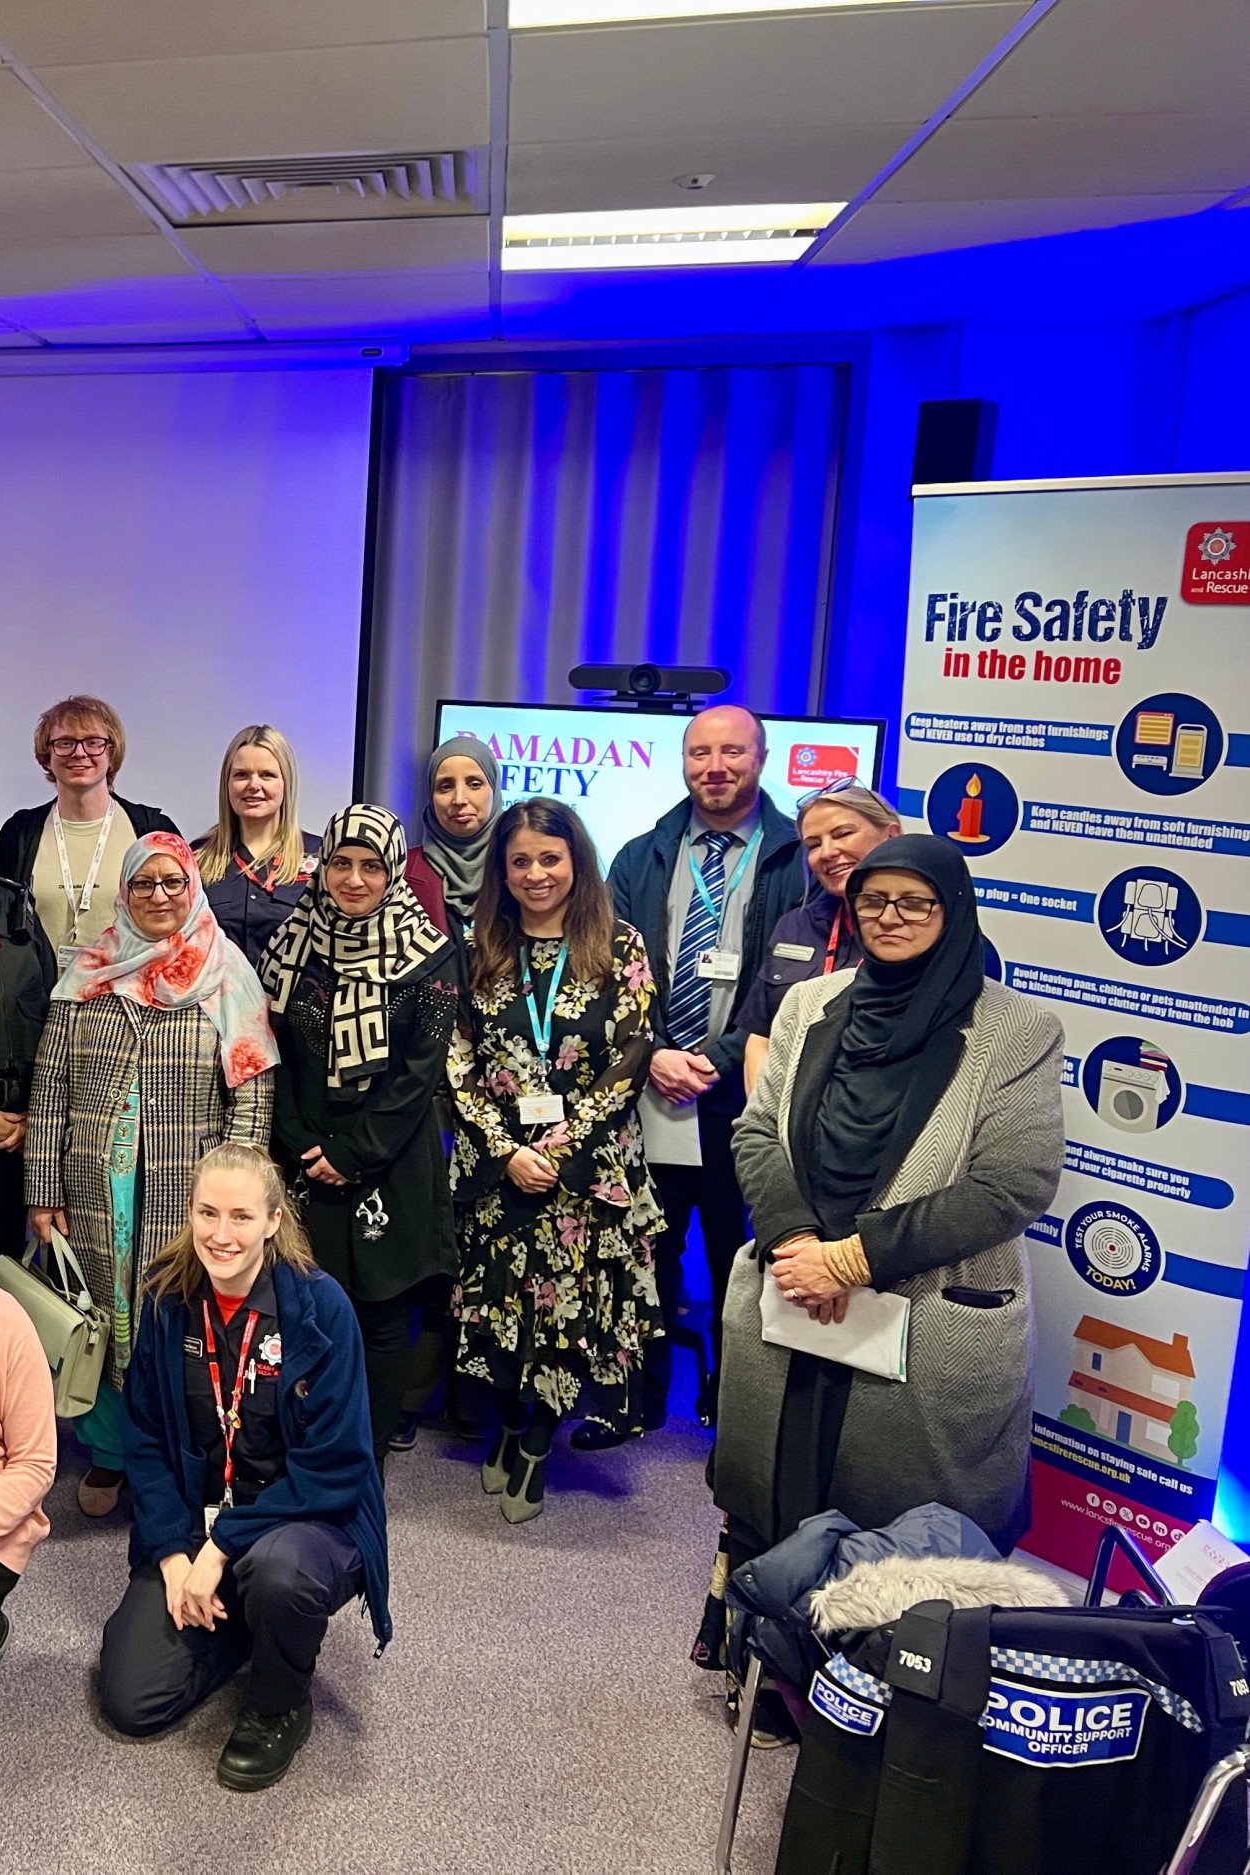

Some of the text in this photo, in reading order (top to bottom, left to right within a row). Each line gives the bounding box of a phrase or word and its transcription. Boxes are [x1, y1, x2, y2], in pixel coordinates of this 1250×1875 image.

[1192, 567, 1250, 580] Lancashi
[1206, 581, 1249, 594] Rescue
[925, 588, 1168, 650] Fire Safety
[943, 648, 1122, 684] in the home
[909, 728, 1045, 748] and NEVER use to dry clothes
[910, 715, 1109, 741] Keep heaters away from soft furnishings
[500, 763, 599, 797] FETY
[792, 767, 848, 777] Lancashire Fire
[1030, 818, 1213, 850] and NEVER leave them unattended
[1031, 805, 1250, 842] Keep candles away from soft furnishing
[974, 887, 985, 898] ne
[985, 888, 1010, 903] plug
[1019, 892, 1040, 906] One
[1041, 896, 1078, 912] socket
[1012, 978, 1234, 1029] the kitchen and move clutter away from the hob
[1013, 966, 1250, 1019] Avoid leaving pans, children or pets unattended in
[1065, 1144, 1083, 1157] and
[1083, 1149, 1117, 1167] always
[1117, 1158, 1145, 1174] make
[1145, 1167, 1169, 1181] sure
[1169, 1173, 1190, 1186] you
[1079, 1160, 1101, 1174] your
[1101, 1166, 1146, 1187] cigarette
[1146, 1178, 1191, 1199] properly
[1029, 1221, 1059, 1238] nthly
[1075, 1210, 1153, 1273] TEST YOUR SMOKE ALARMS
[1085, 1265, 1137, 1291] TODAY!
[1034, 1422, 1193, 1496] information on staying safe call us
[899, 1649, 932, 1673] 7053
[816, 1681, 873, 1721] POLICE
[986, 1691, 1133, 1732] POLICE
[985, 1715, 1132, 1744] OMMUNITY SUPPORT
[1028, 1742, 1089, 1755] OFFICER
